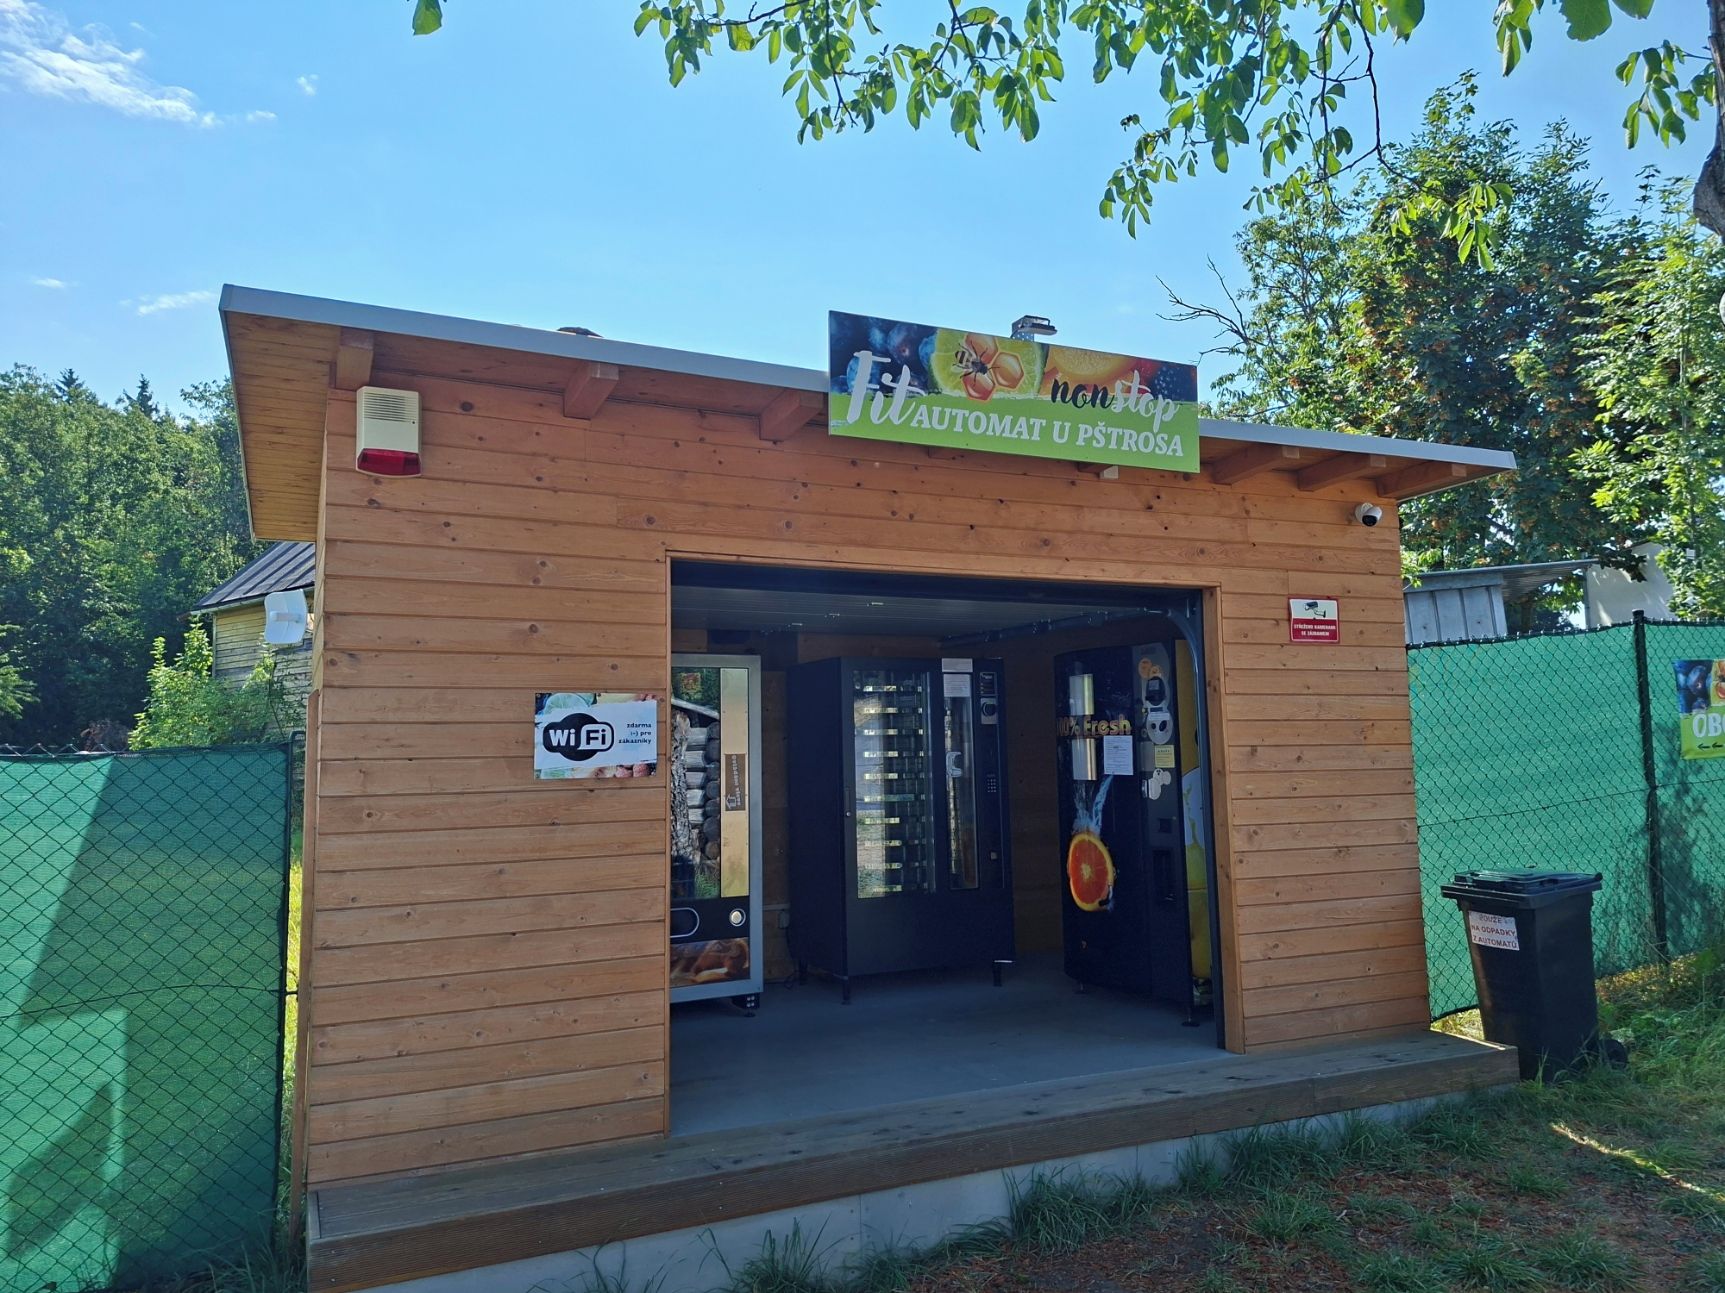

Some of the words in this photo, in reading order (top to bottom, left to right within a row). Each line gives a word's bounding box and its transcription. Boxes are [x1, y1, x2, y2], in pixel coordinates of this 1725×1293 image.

[1050, 370, 1181, 432] nonstop
[910, 404, 1046, 441] AUTOMAT
[1051, 423, 1071, 444] U
[1077, 422, 1184, 457] PŠTROSA
[1083, 714, 1132, 736] Fresh
[1692, 713, 1725, 738] OB
[549, 729, 607, 746] WiFi
[1481, 926, 1516, 936] ODPADKY
